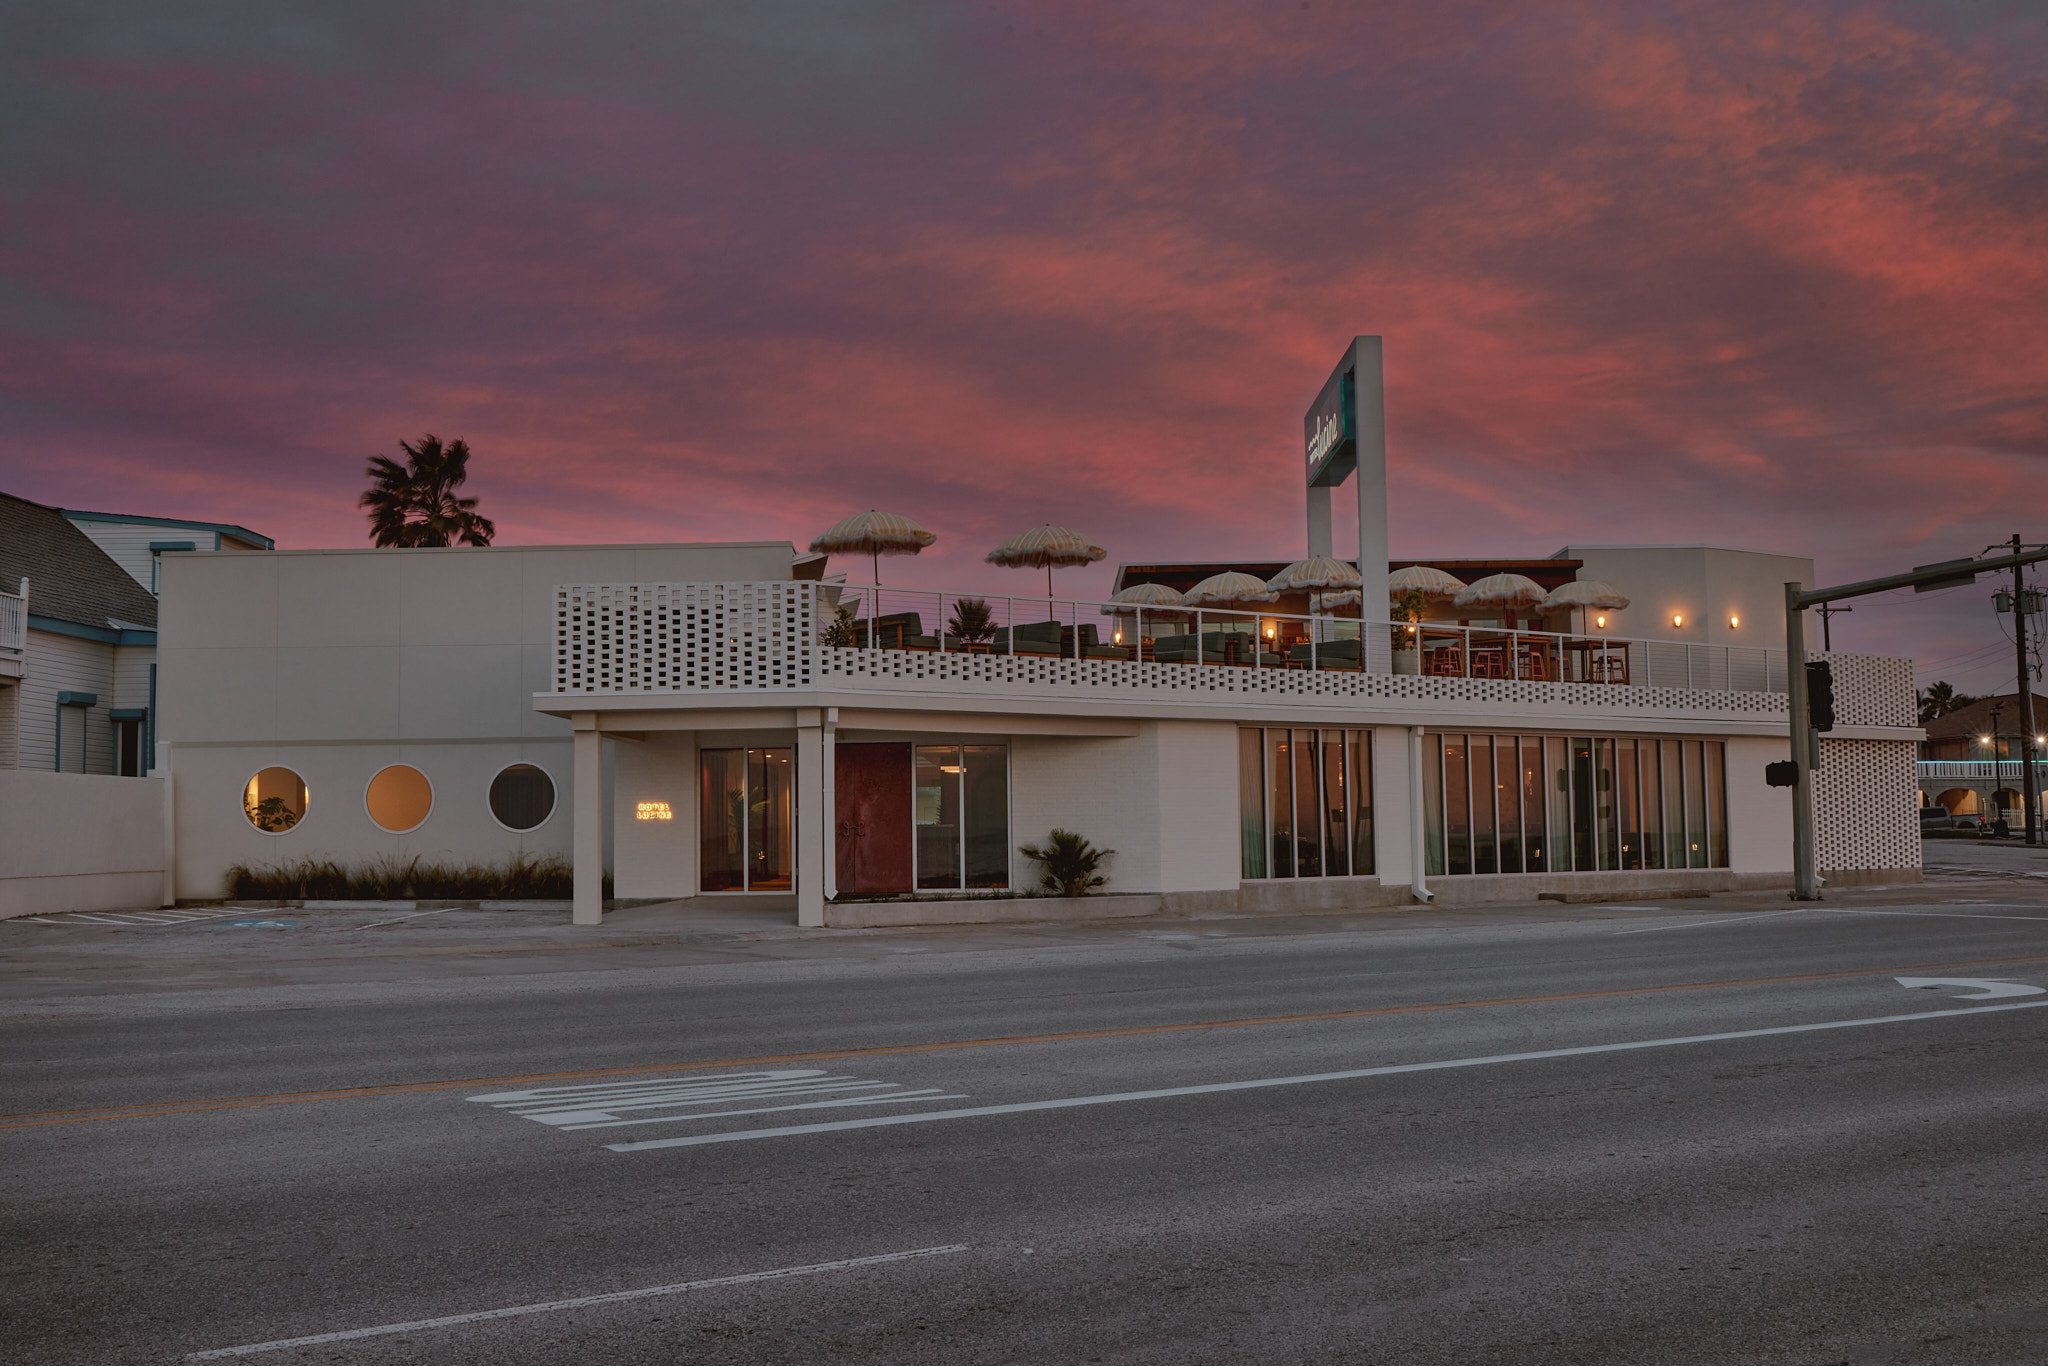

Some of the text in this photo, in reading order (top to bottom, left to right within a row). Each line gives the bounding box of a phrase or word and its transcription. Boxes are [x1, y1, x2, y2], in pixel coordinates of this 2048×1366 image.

[637, 802, 670, 811] HOTEL
[636, 811, 673, 820] LUCINE
[465, 1069, 971, 1131] ONLY
